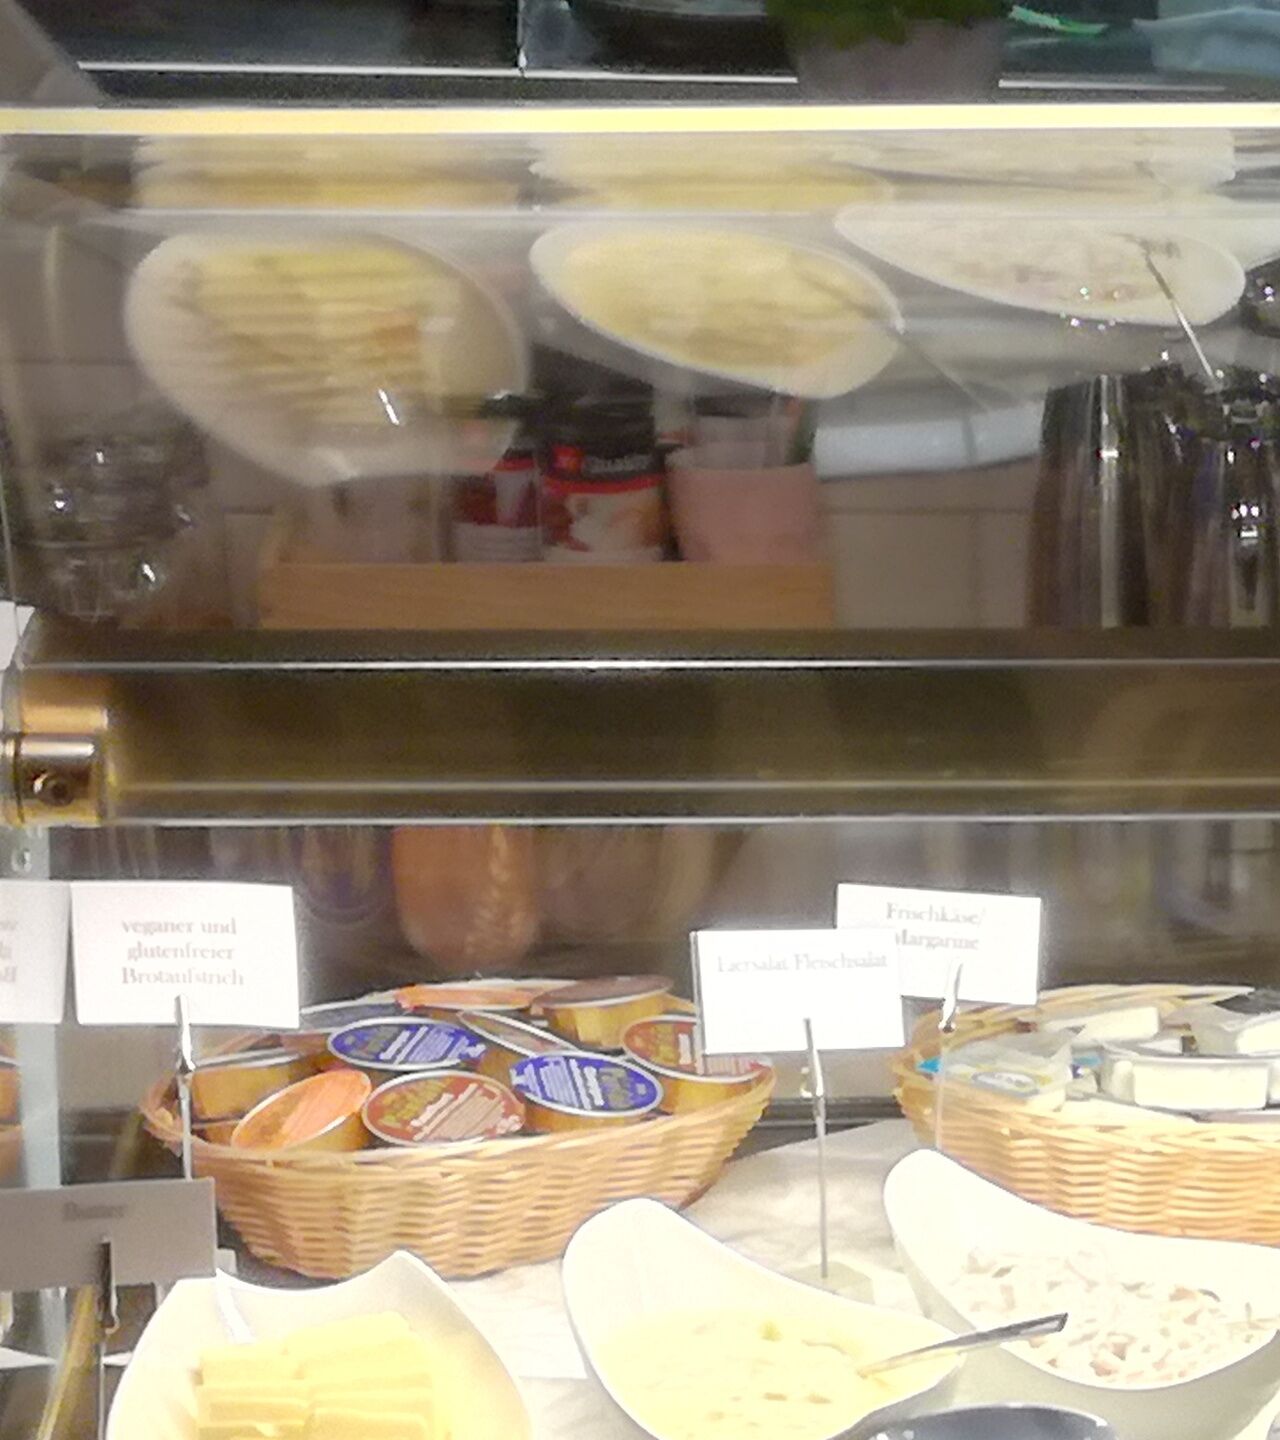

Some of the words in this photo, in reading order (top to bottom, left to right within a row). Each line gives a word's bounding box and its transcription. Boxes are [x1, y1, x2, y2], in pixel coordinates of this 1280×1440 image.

[121, 918, 194, 936] veganer
[201, 917, 237, 936] und
[127, 940, 236, 962] glutenfreier
[121, 966, 245, 986] Brotaufstrich
